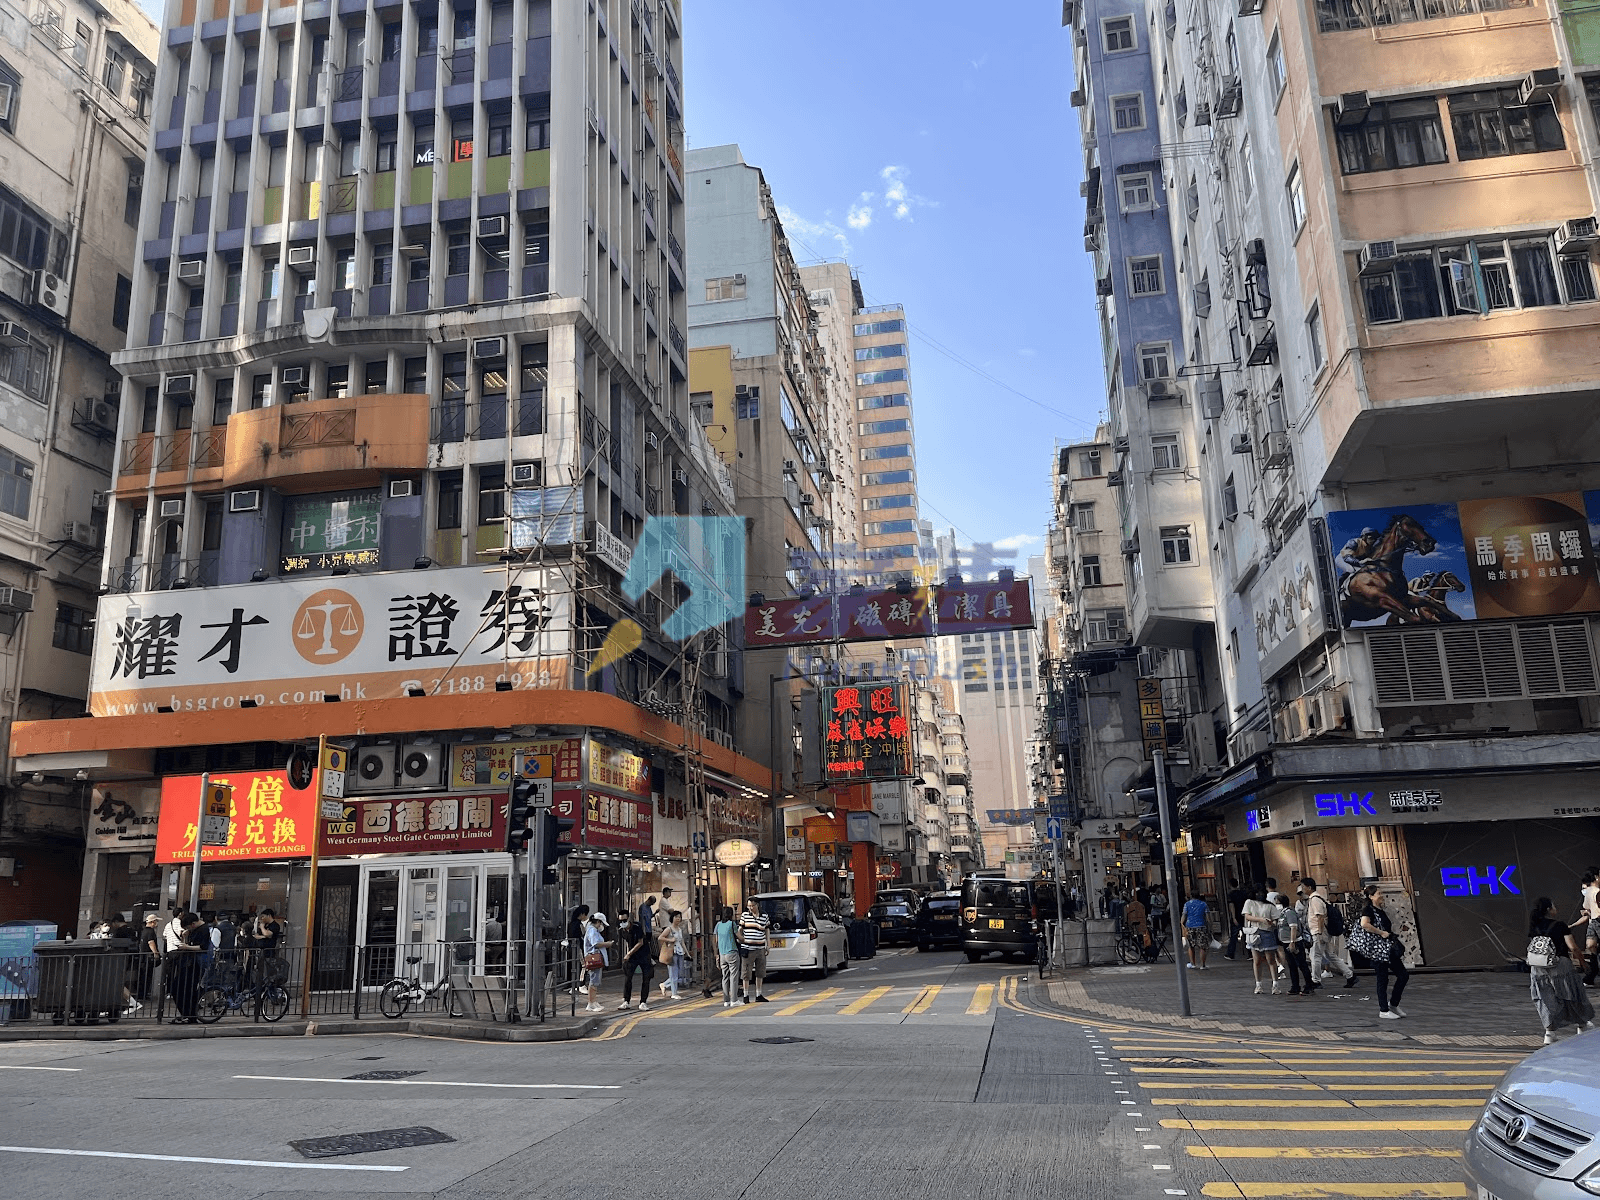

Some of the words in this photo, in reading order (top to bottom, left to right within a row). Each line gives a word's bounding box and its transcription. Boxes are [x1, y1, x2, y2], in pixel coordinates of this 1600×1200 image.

[1474, 530, 1584, 566] 馬季開鑼
[110, 608, 270, 681] 耀才
[388, 585, 552, 662] 證券
[754, 606, 822, 638] 美光
[832, 687, 899, 717] 興旺
[363, 796, 493, 834] 西德鋼閘
[1314, 791, 1377, 817] SHK
[172, 850, 214, 858] TRILLON
[218, 847, 251, 856] MONEY
[256, 845, 306, 854] EXCHANGE
[219, 832, 226, 840] 12
[327, 837, 345, 845] West
[346, 835, 382, 845] Germany
[383, 834, 402, 842] Steel
[403, 833, 422, 842] Gate
[423, 832, 460, 842] Company
[461, 830, 493, 839] Limited
[1440, 865, 1521, 897] SHK
